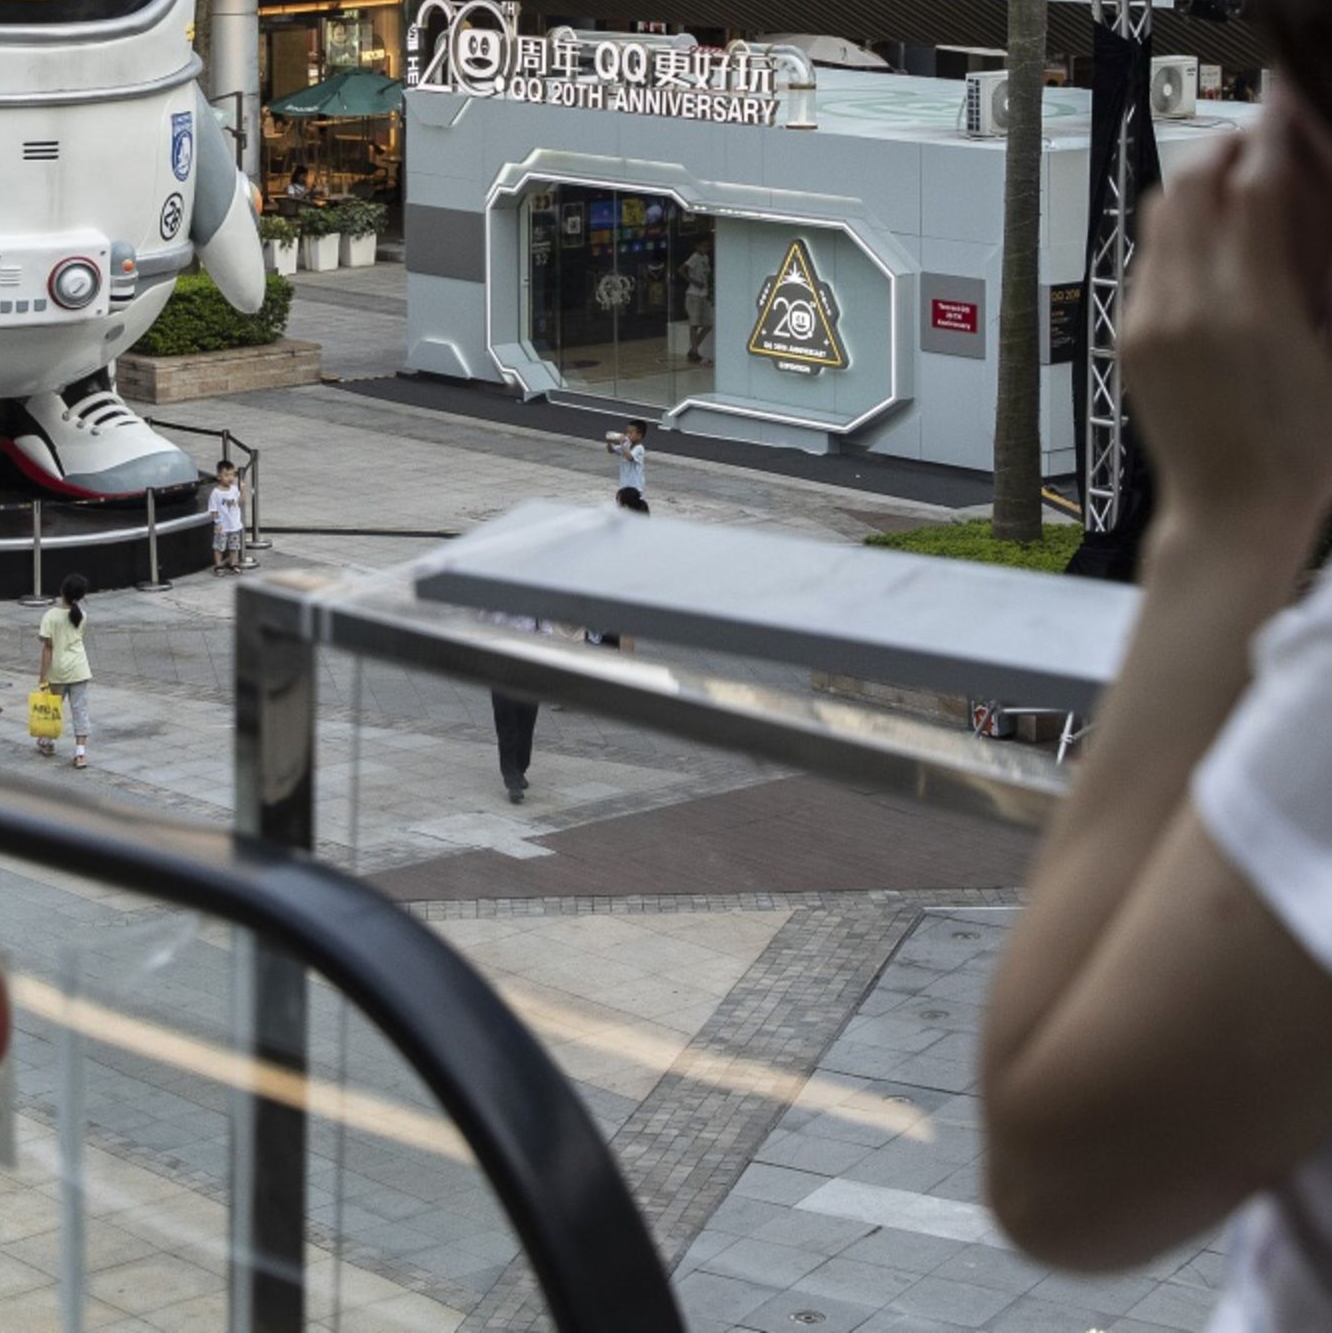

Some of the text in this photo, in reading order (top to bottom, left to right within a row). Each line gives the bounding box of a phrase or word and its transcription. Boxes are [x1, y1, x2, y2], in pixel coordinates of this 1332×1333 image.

[516, 36, 775, 94] 周年 QQ 更好玩
[510, 77, 777, 125] QQ 20TH ANNIVERSARY
